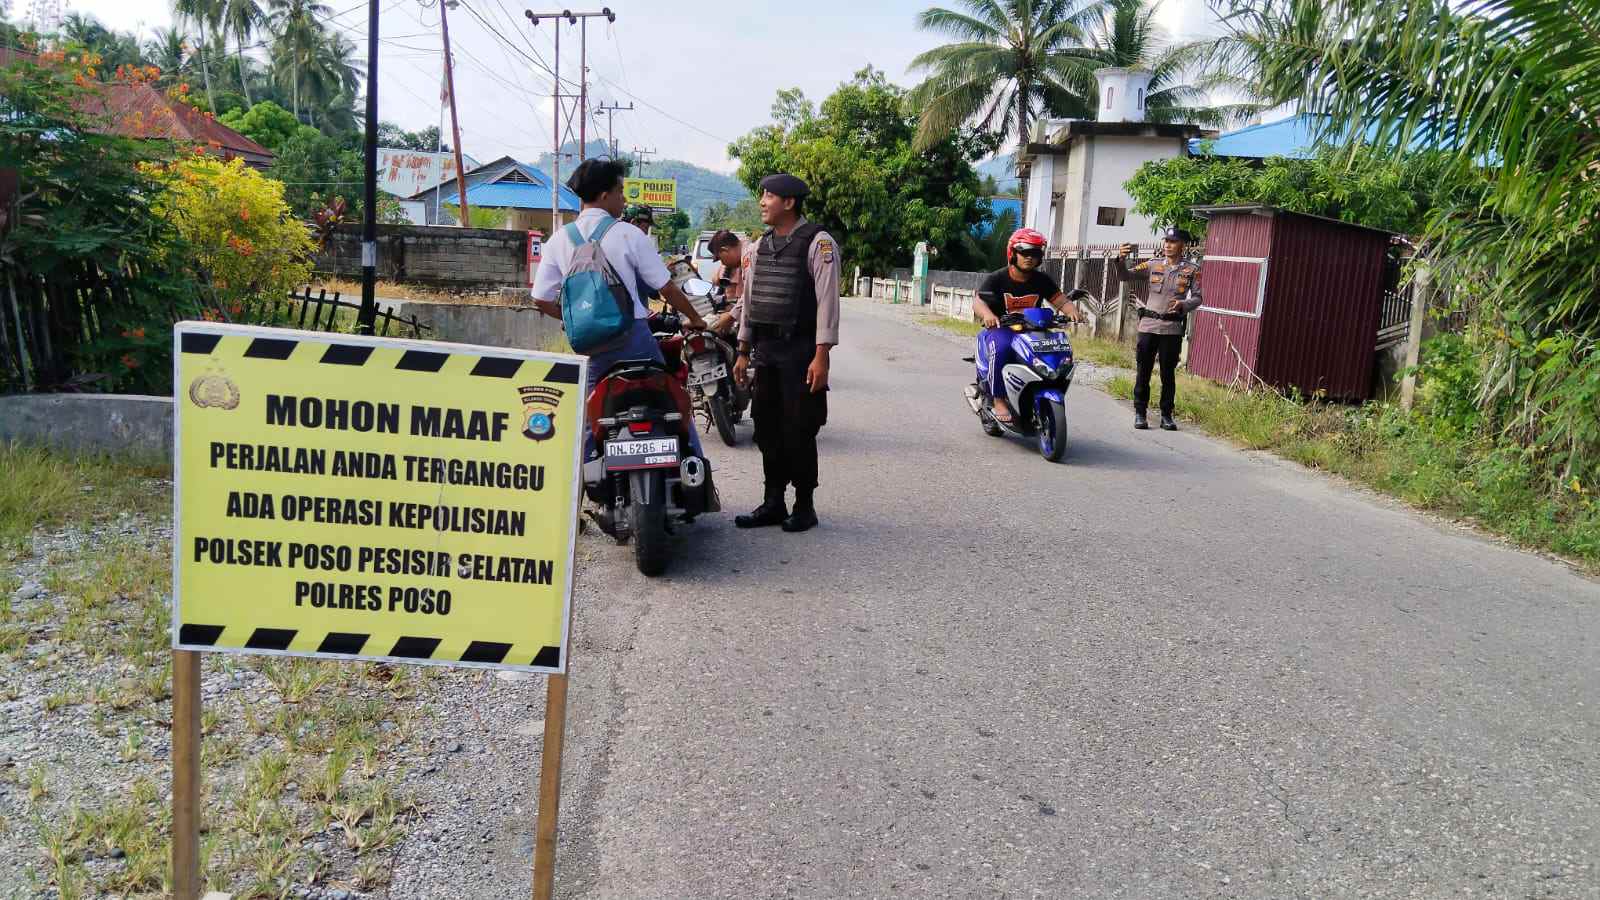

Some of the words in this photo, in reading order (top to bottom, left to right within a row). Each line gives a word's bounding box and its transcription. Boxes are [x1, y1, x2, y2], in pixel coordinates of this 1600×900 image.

[643, 182, 673, 192] POLISI
[643, 192, 673, 202] POLICE
[267, 395, 399, 433] MOHON
[411, 406, 509, 441] MAAF
[211, 442, 325, 474] PERJALAN
[332, 451, 397, 480] ANDA
[404, 456, 544, 491] TERGANGGU
[227, 492, 275, 519] ADA
[282, 495, 382, 526] OPERASI
[389, 502, 525, 536] KEPOLISIAN
[195, 537, 282, 567] POLSEK
[289, 543, 351, 571] POSO
[359, 547, 450, 577] PESISIR
[458, 554, 553, 585] SELATAN
[296, 582, 381, 611] POLRES
[389, 587, 451, 615] POSO
